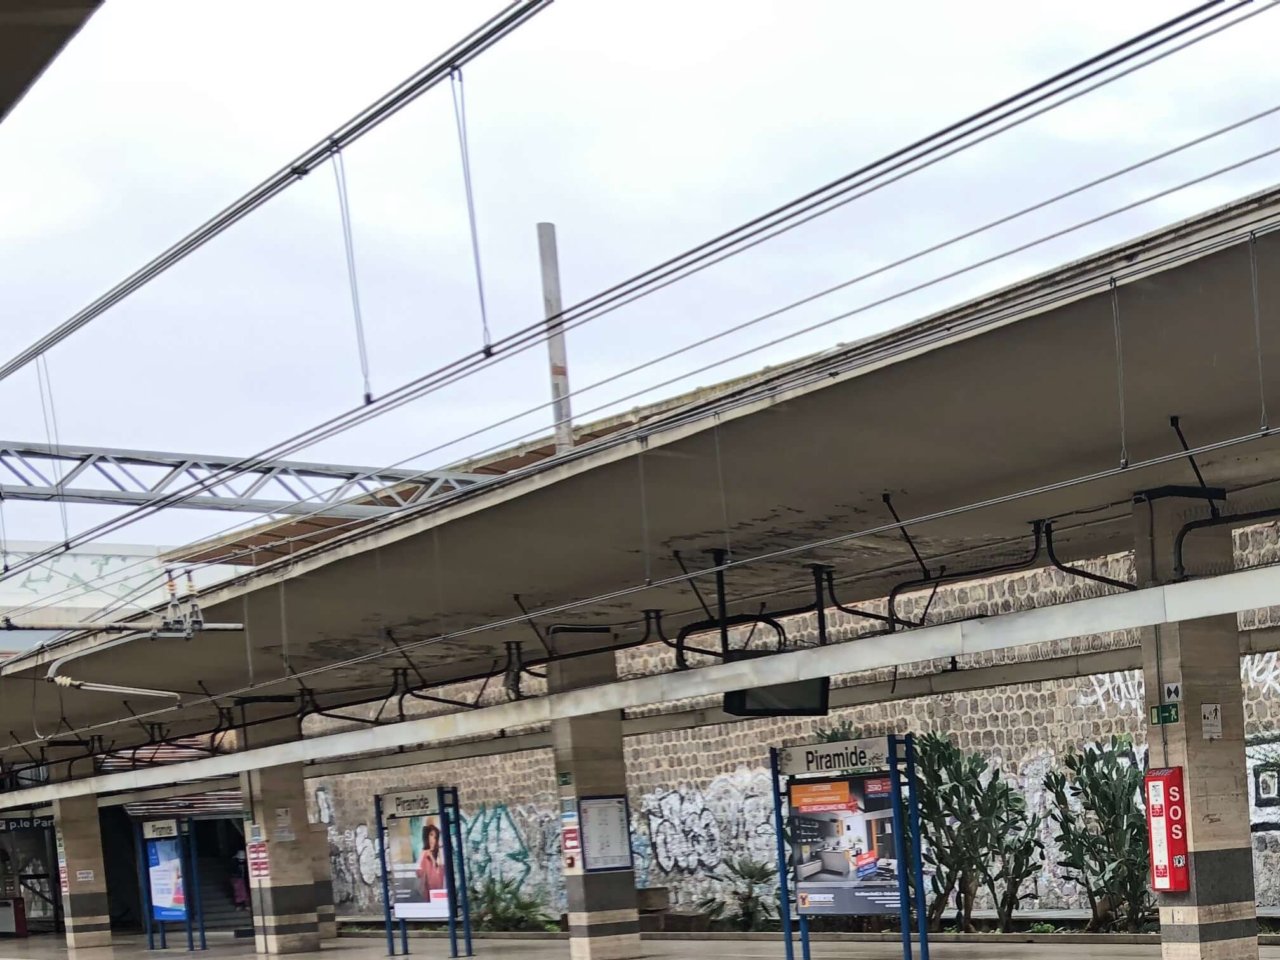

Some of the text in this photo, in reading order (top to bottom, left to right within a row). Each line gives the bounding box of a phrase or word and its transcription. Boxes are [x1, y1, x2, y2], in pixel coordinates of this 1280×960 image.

[806, 746, 867, 771] Piramide
[395, 794, 429, 811] Piramide
[1169, 786, 1183, 839] SOS
[10, 819, 30, 830] p.le
